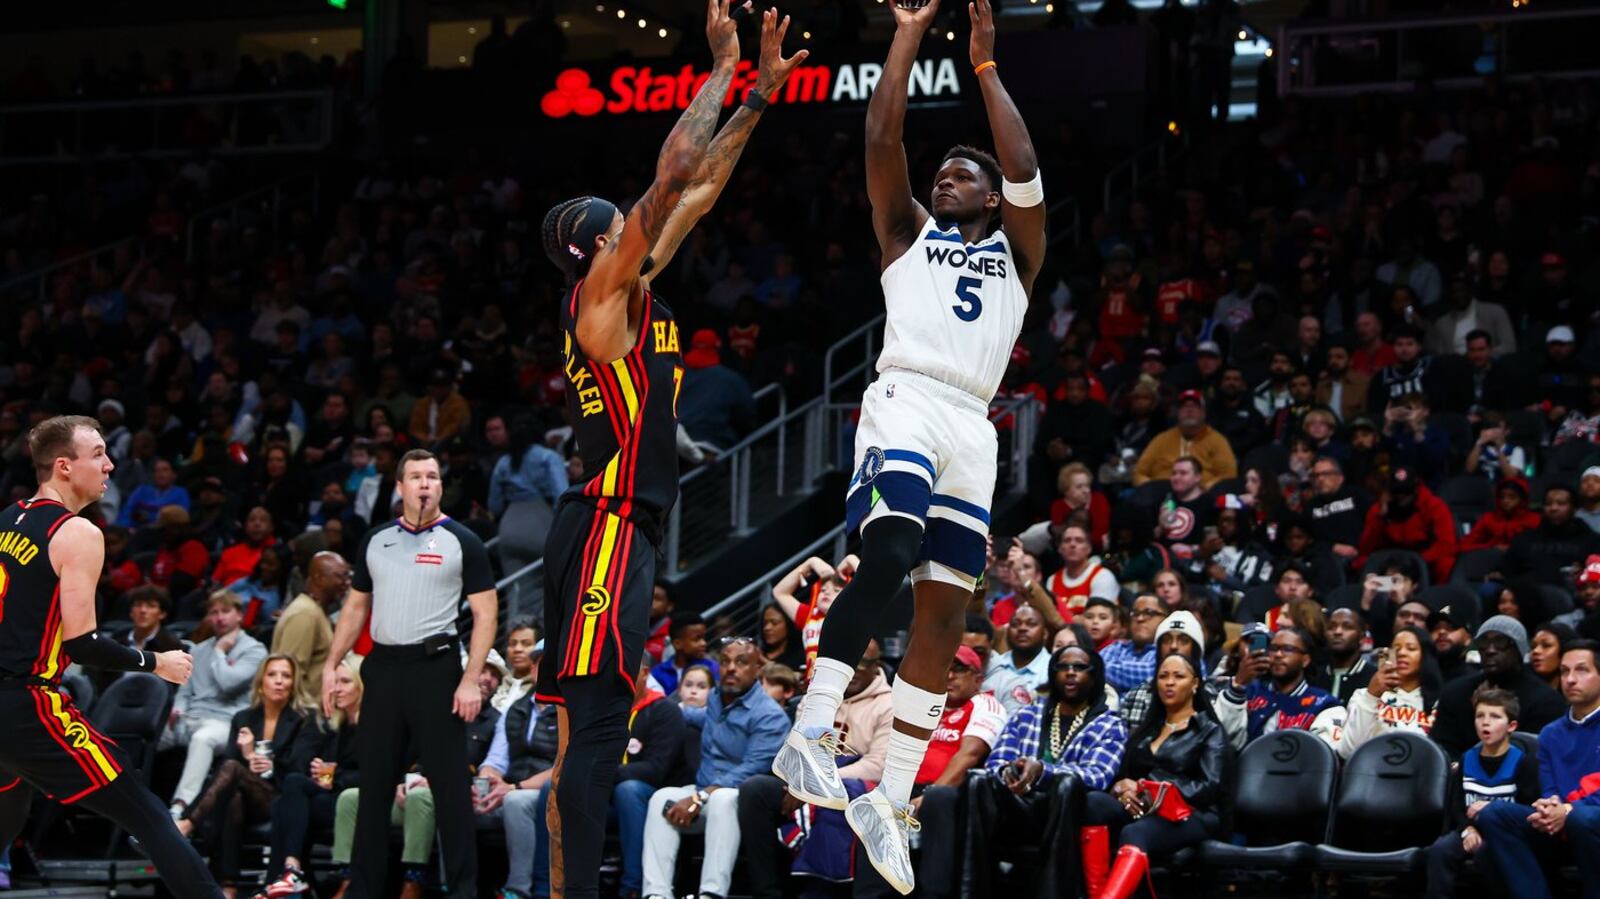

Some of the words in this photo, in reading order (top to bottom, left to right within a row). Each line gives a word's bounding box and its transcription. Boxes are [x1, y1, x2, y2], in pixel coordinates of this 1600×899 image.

[832, 58, 960, 101] ARNA
[952, 275, 982, 322] 5
[652, 320, 680, 353] HA
[564, 329, 604, 418] LKER
[672, 364, 685, 419] 7
[927, 705, 942, 717] 5
